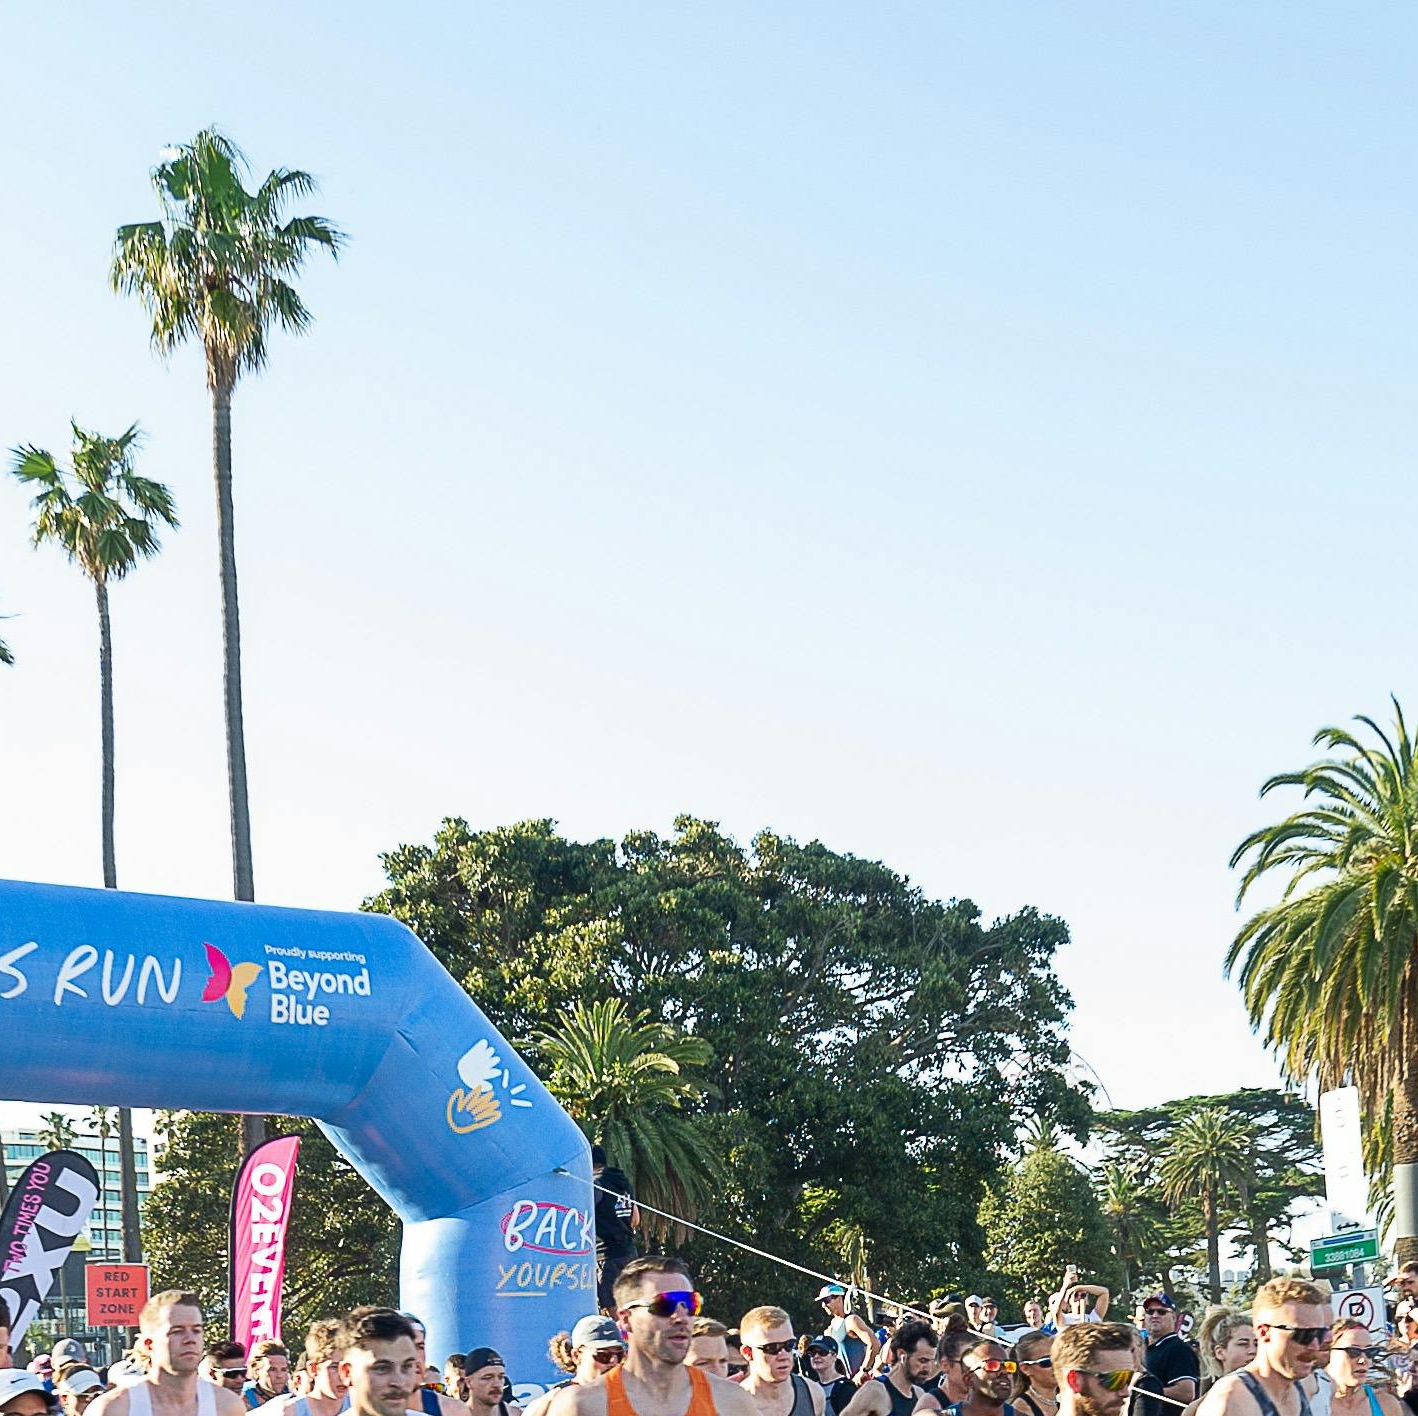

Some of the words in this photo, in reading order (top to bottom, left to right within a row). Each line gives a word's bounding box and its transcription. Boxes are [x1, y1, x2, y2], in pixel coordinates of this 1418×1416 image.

[264, 944, 306, 959] Proudly
[308, 950, 366, 965] supporting
[54, 944, 181, 1006] RUN
[268, 960, 371, 1001] Beyond
[271, 993, 330, 1026] Blue
[29, 1162, 52, 1192] YOU
[13, 1194, 43, 1240] TIMES
[504, 1199, 595, 1252] BACK
[3, 1240, 28, 1274] TWO
[251, 1163, 287, 1340] O2EVENT
[96, 1287, 138, 1298] START
[104, 1271, 130, 1282] RED
[100, 1303, 135, 1314] ZONE
